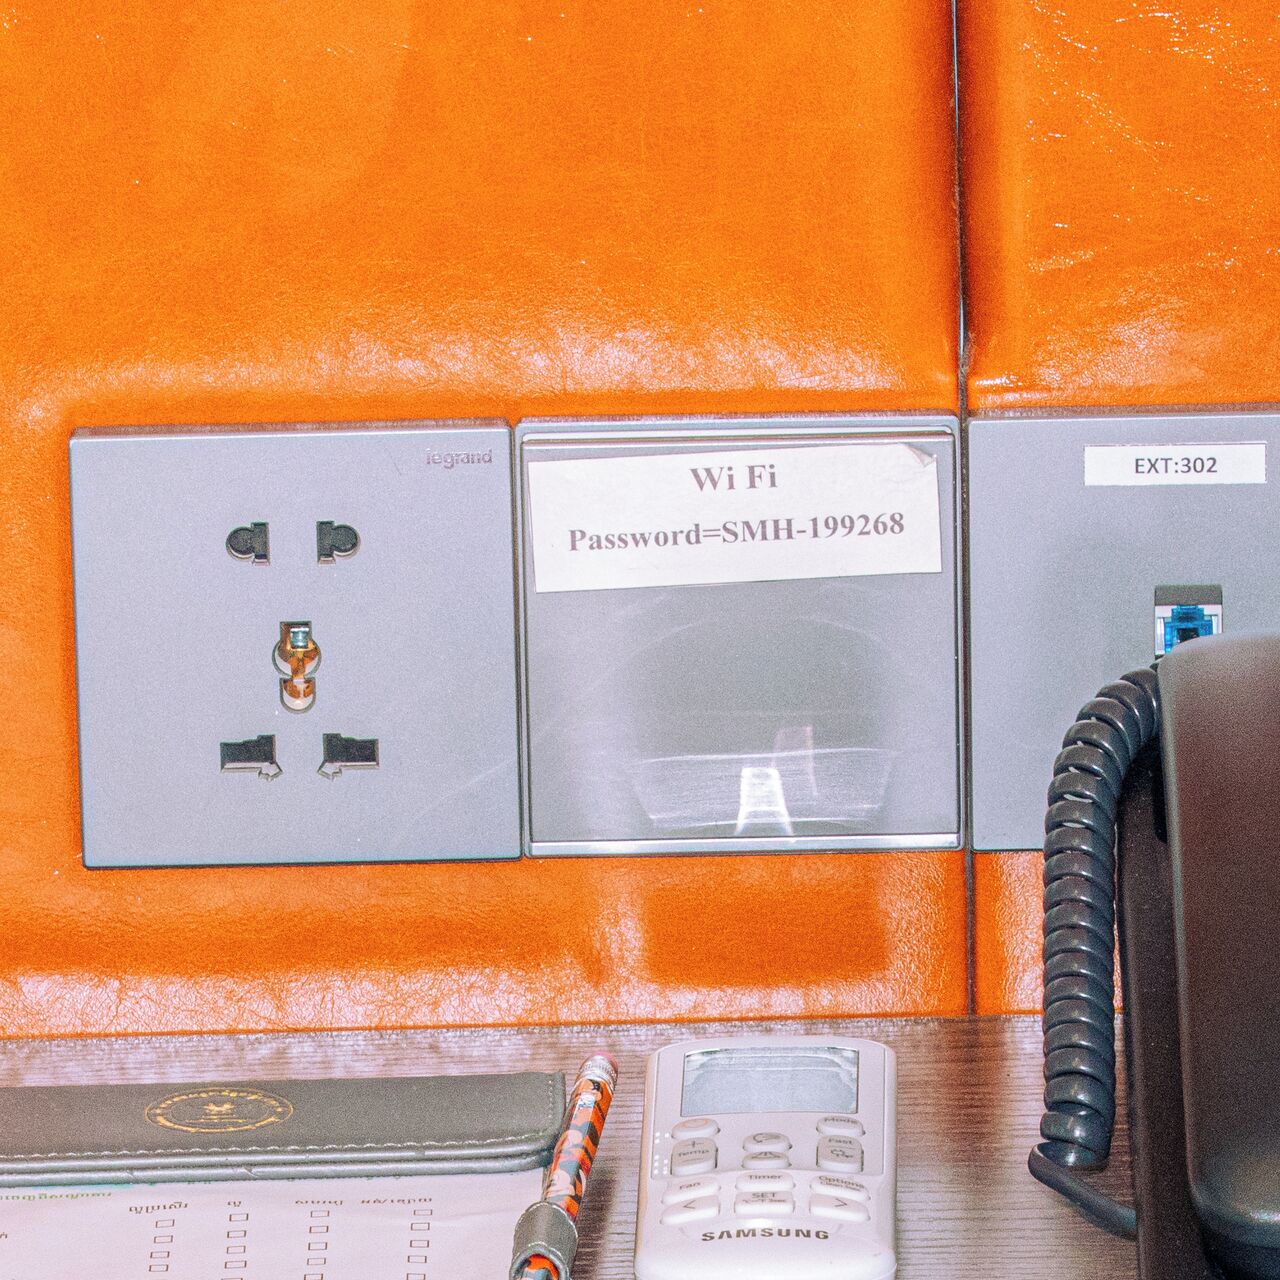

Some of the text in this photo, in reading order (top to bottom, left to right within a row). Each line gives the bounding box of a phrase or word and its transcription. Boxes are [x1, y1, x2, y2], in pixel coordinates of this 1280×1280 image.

[426, 449, 492, 469] legrand
[1135, 457, 1218, 474] EXT:302
[691, 464, 778, 492] Wi Fi
[569, 512, 905, 551] Password=SMH-199268
[701, 1228, 830, 1243] SAMSUNG
